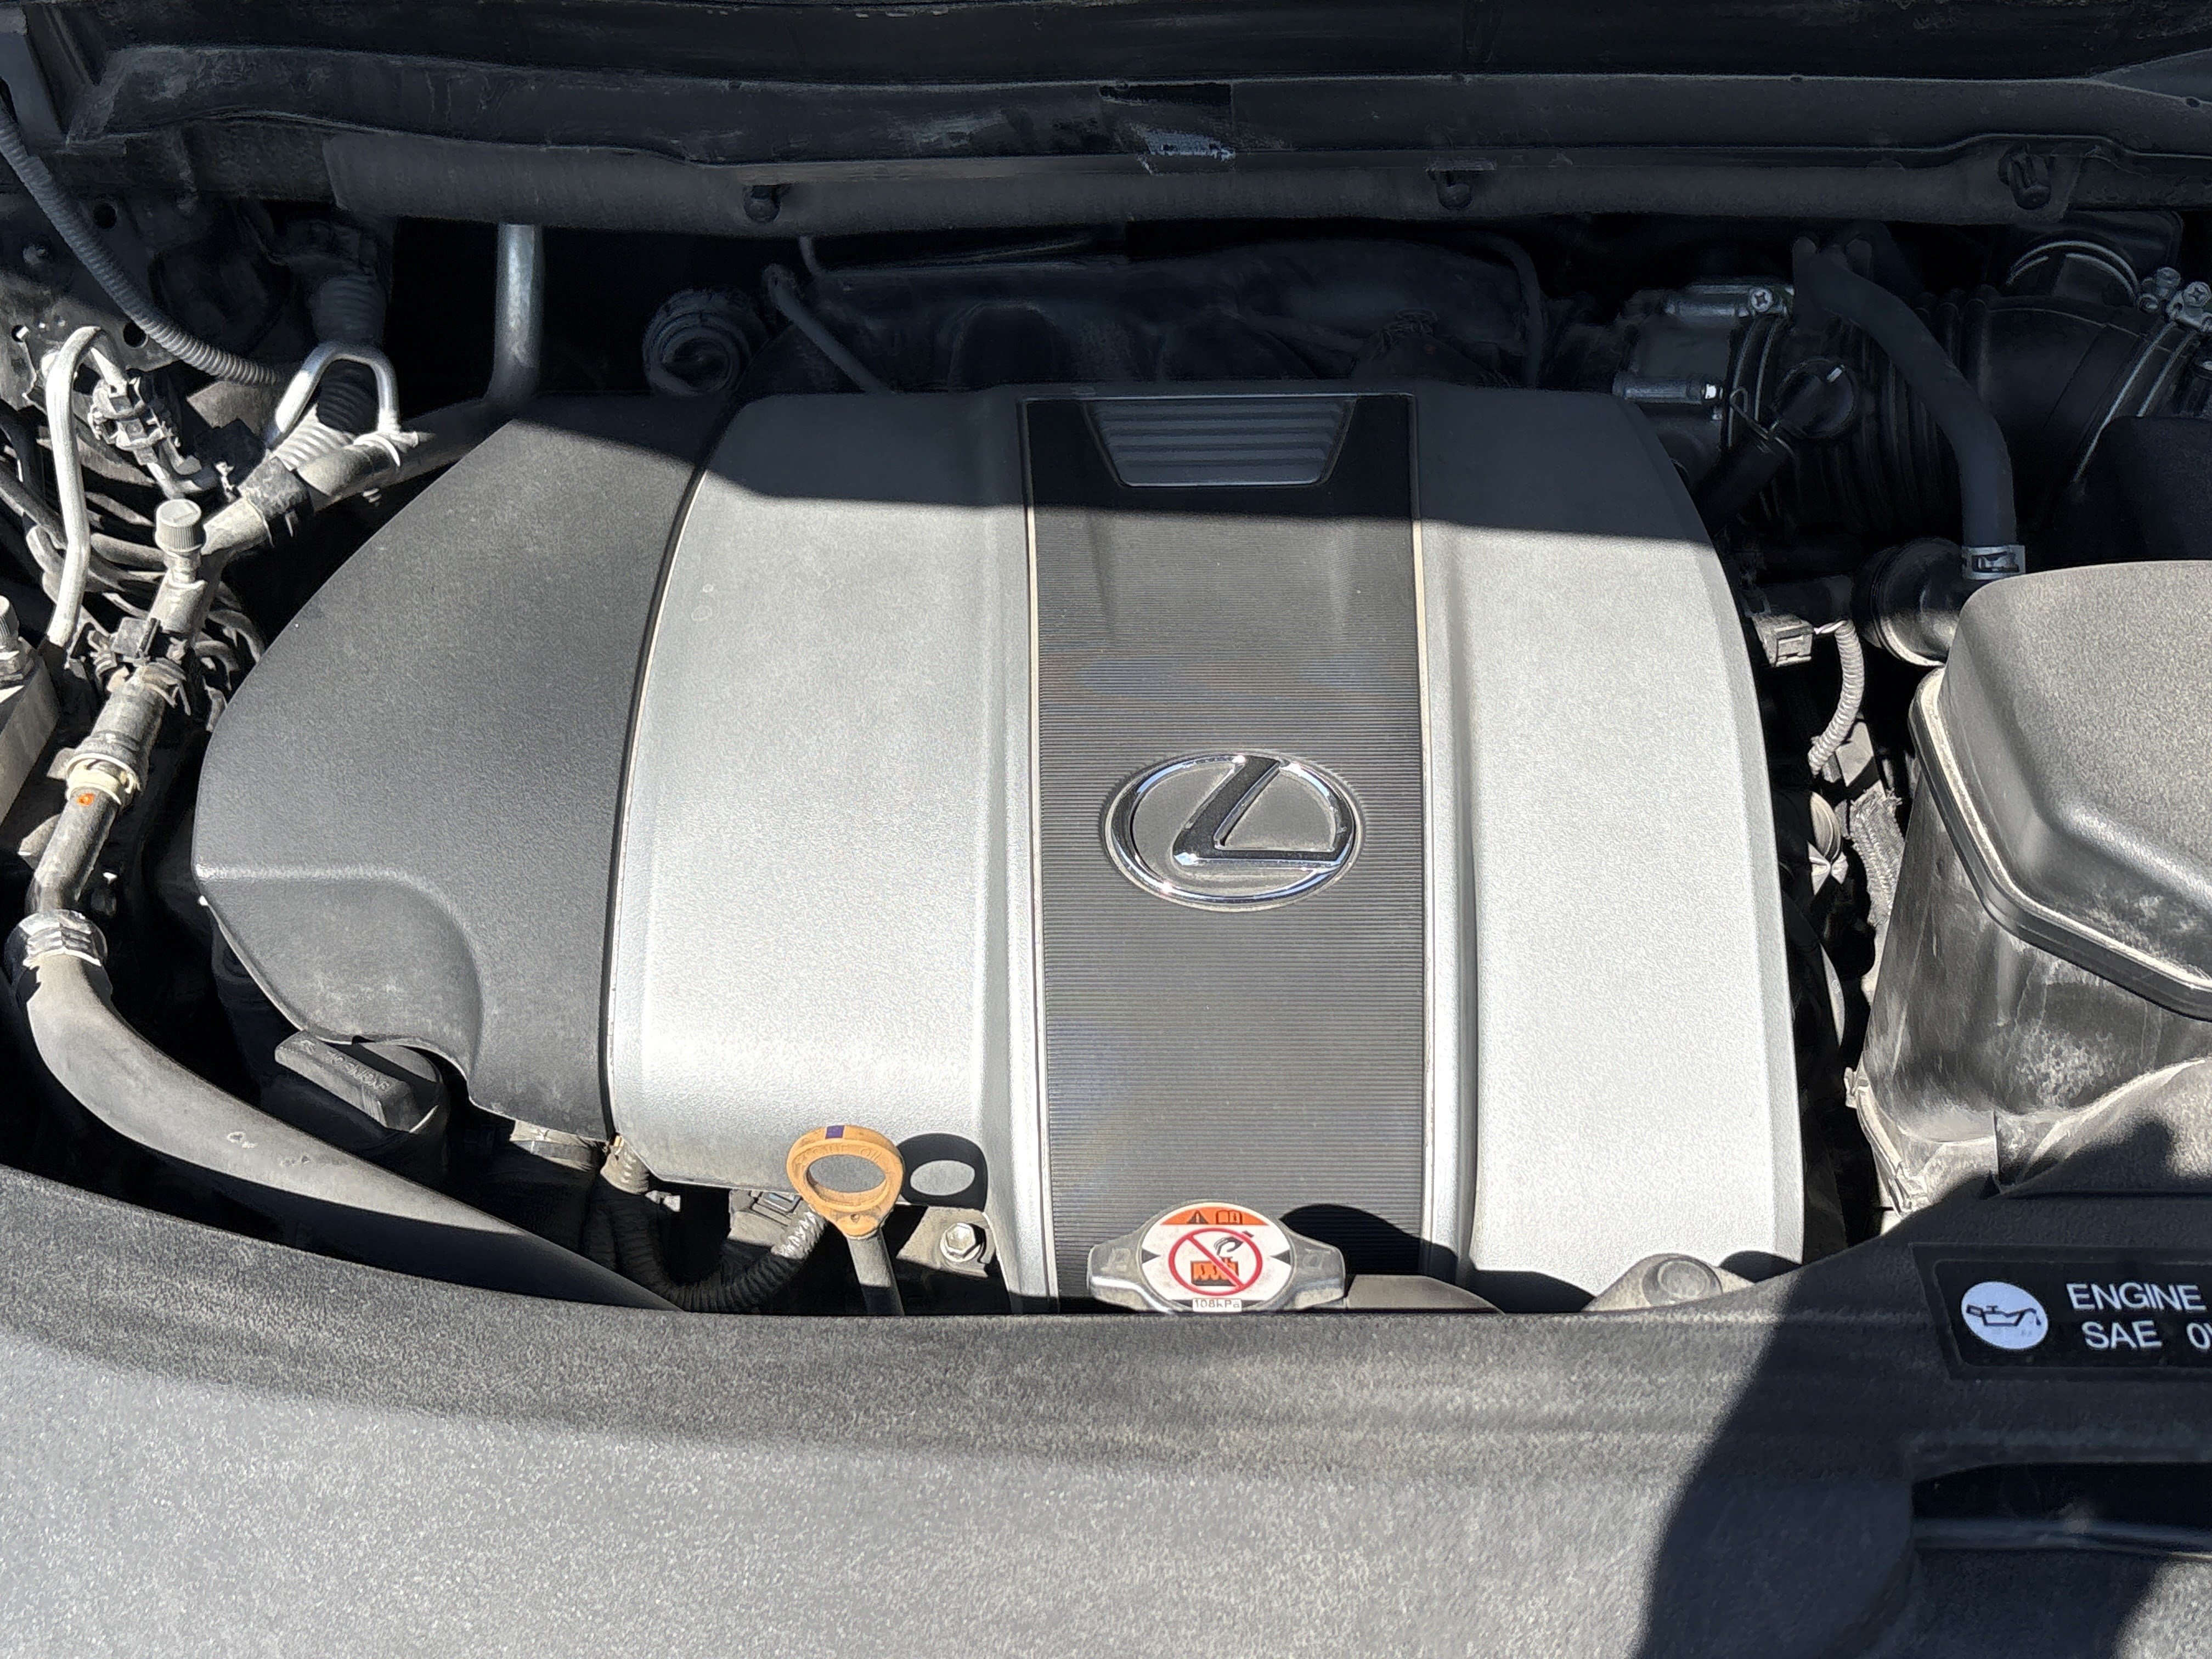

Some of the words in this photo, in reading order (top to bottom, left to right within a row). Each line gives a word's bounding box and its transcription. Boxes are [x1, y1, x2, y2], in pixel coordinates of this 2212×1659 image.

[1195, 1298, 1240, 1308] 108kPa
[2066, 1282, 2207, 1311] ENGINE
[2081, 1319, 2163, 1350] SAE
[2186, 1322, 2212, 1350] 0
